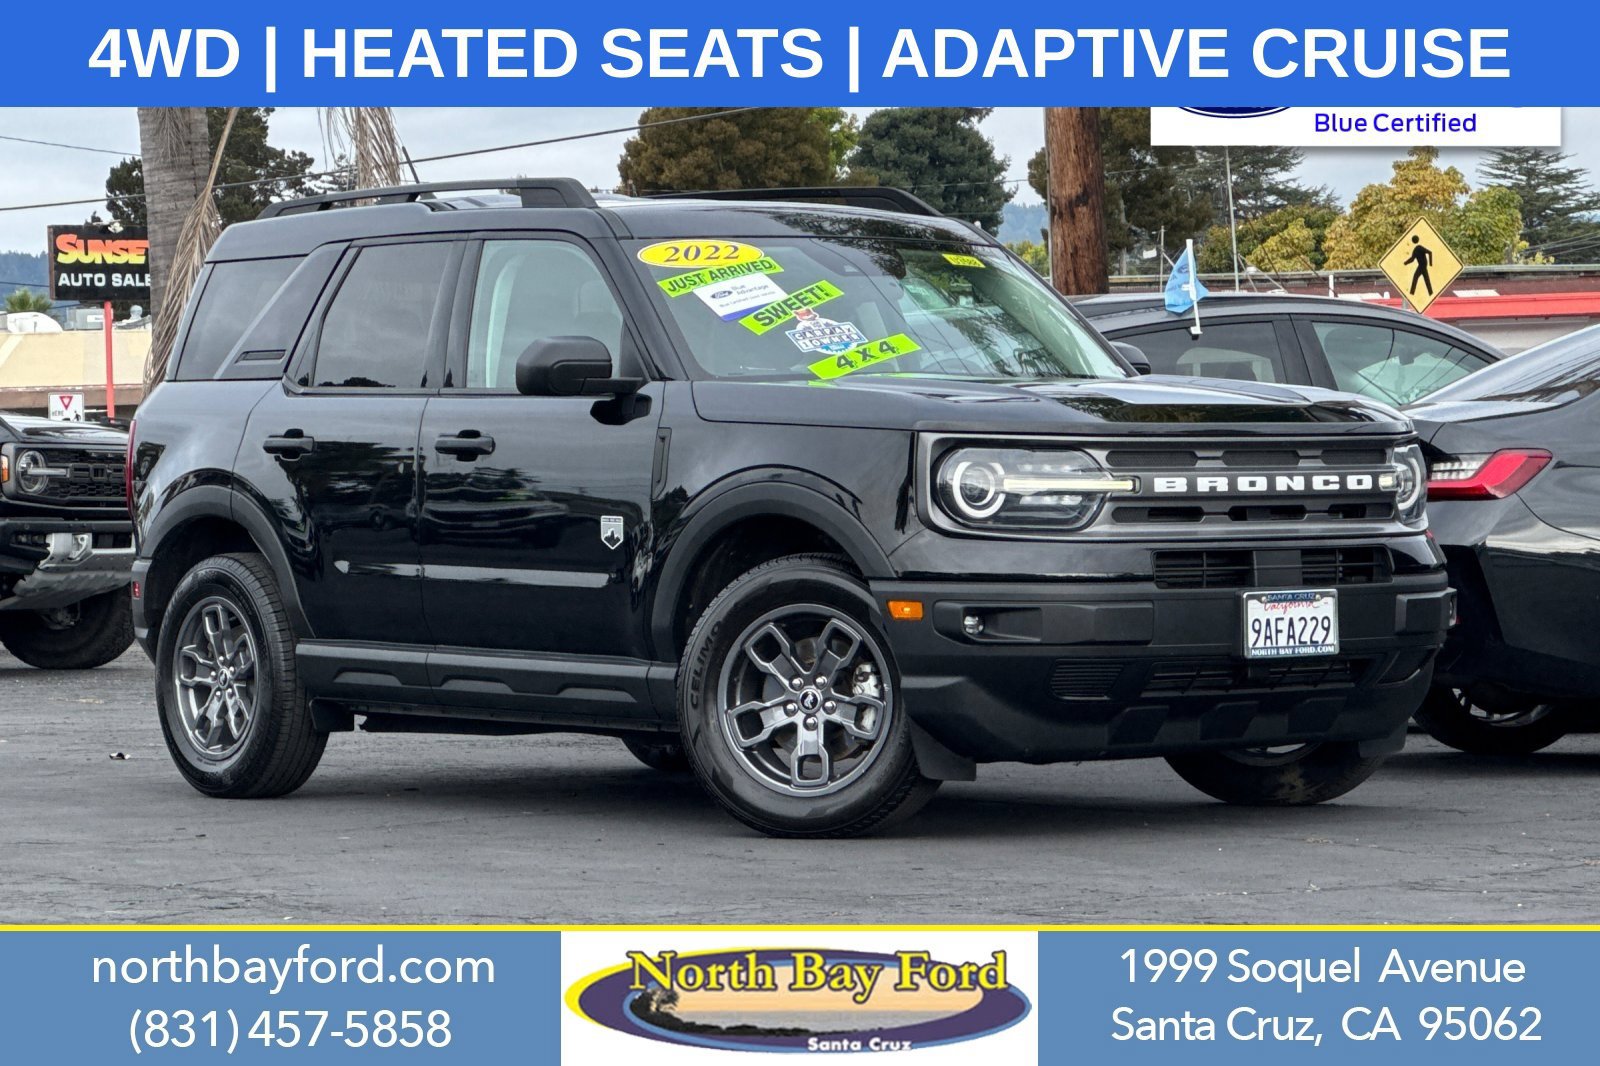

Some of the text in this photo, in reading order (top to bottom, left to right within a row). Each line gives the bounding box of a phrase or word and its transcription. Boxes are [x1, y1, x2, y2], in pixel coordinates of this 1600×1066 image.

[56, 234, 149, 264] SUNSE
[664, 244, 740, 262] 2022
[58, 273, 151, 287] AUTO SALE
[668, 259, 774, 292] JUST ARRIVED
[753, 284, 832, 327] SWEET!
[795, 325, 854, 340] CARFAX
[811, 334, 861, 347] OWNER
[1153, 474, 1373, 494] BRONCO
[1267, 592, 1316, 601] SANTA CRUZ
[1252, 615, 1331, 647] 9AFA229
[1252, 648, 1277, 656] NORTH
[1280, 647, 1294, 655] BAY
